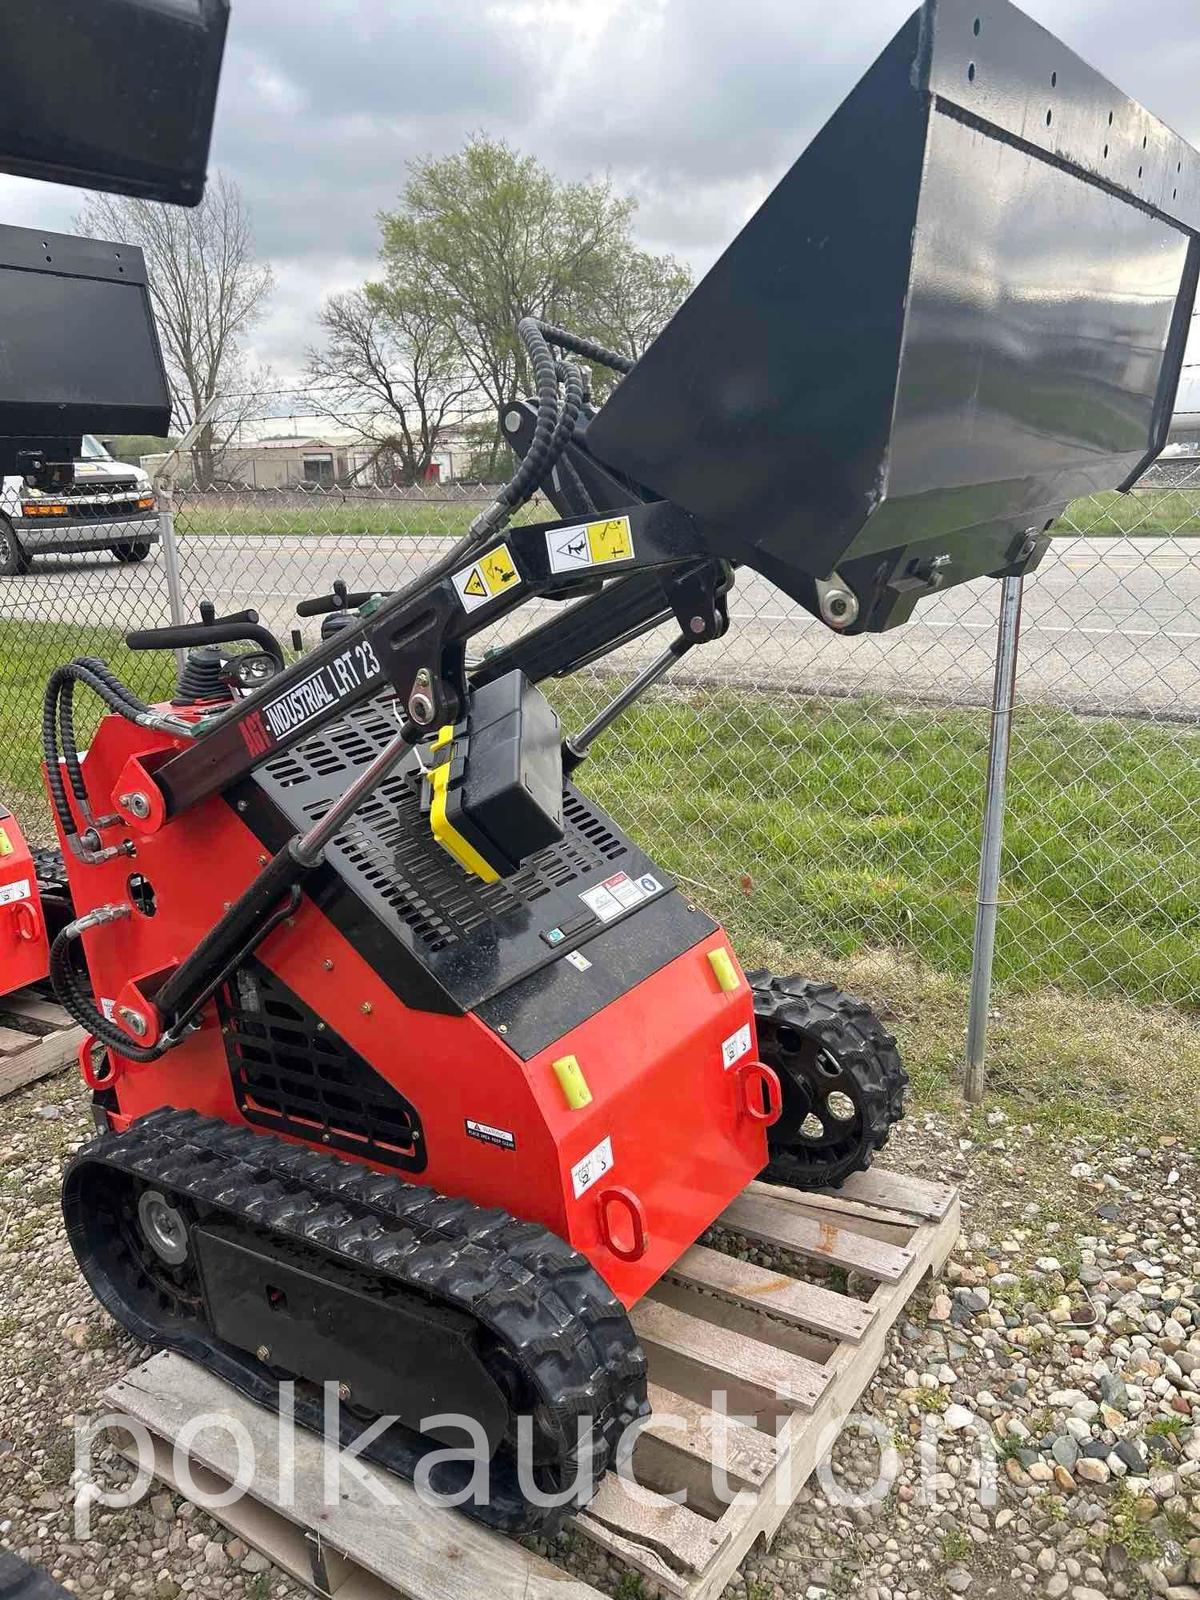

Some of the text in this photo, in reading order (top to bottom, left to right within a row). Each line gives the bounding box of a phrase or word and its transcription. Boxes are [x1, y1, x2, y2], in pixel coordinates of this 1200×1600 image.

[266, 674, 334, 736] INDUSTRIAL
[327, 651, 361, 696] LRT
[355, 641, 381, 679] 23
